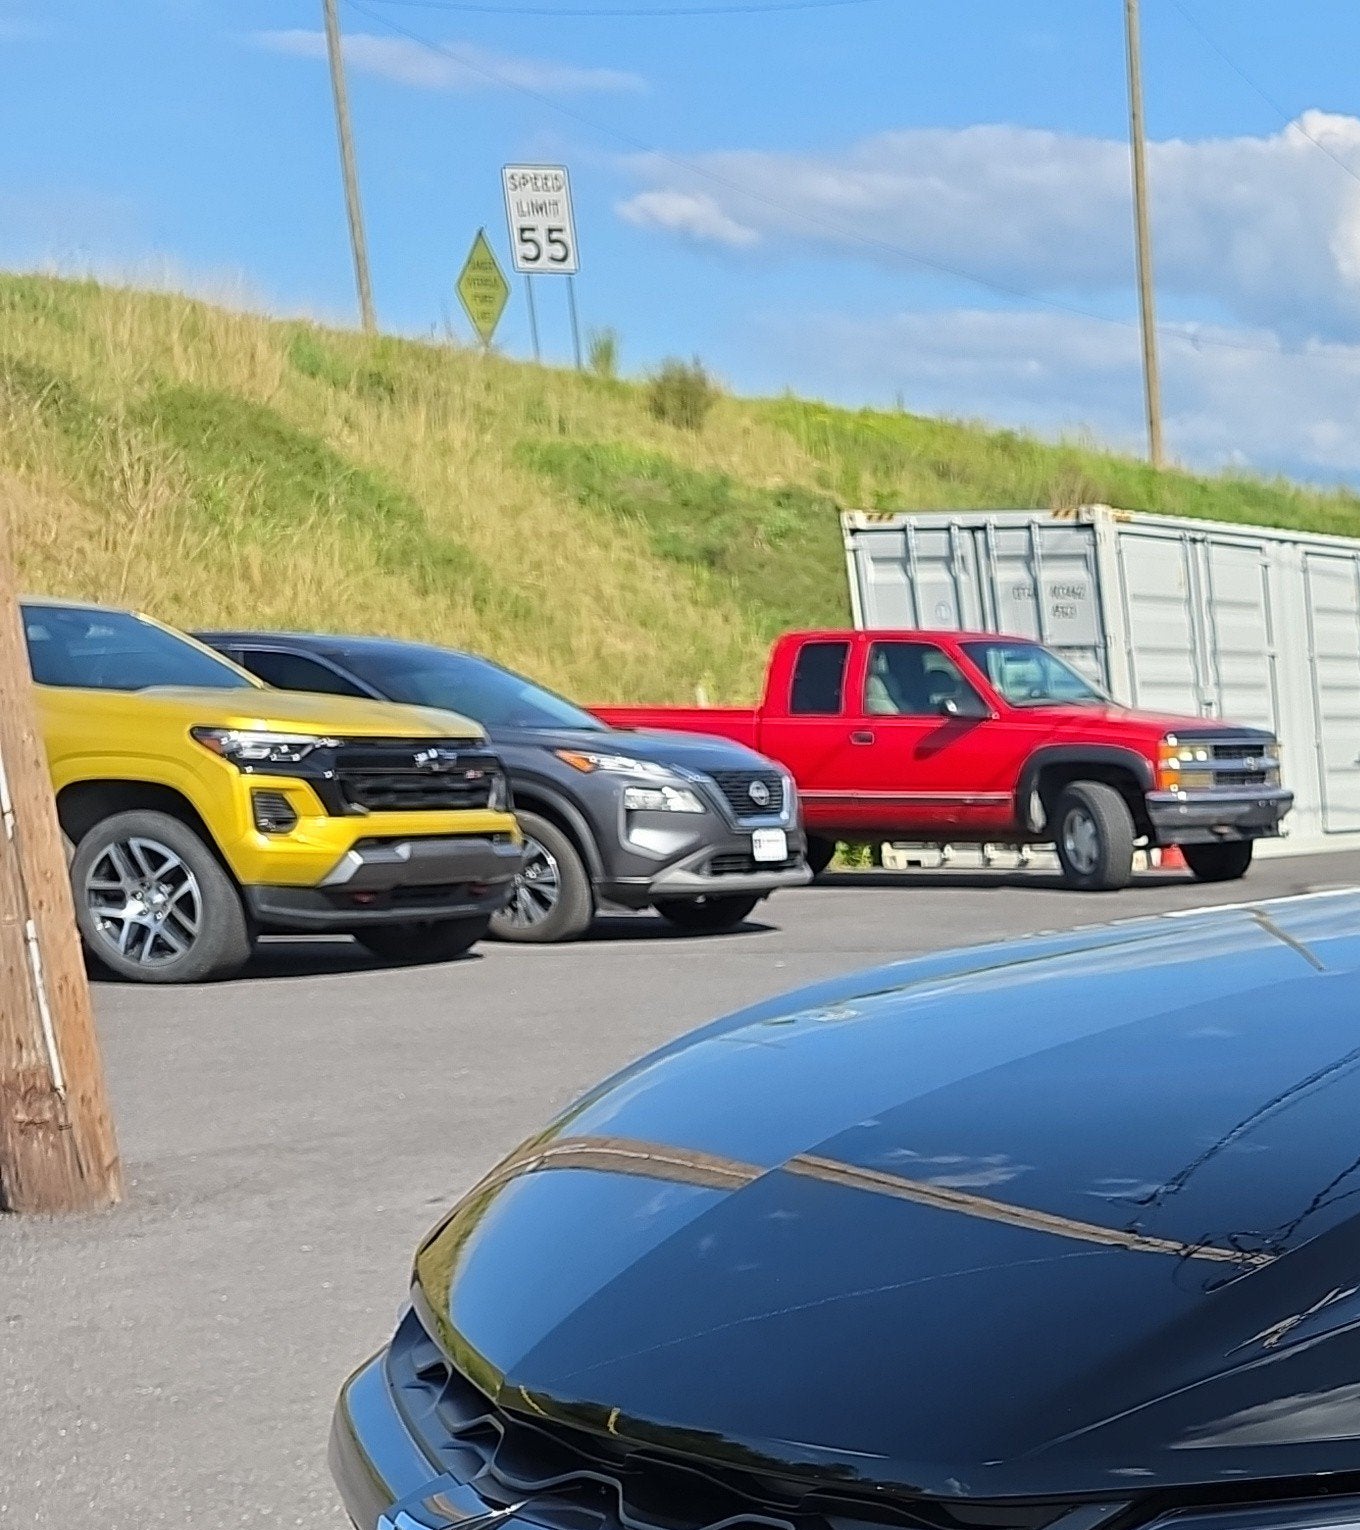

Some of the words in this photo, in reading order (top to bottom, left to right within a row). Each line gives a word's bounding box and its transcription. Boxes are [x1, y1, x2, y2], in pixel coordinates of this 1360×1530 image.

[508, 172, 565, 193] SPEED
[516, 200, 560, 218] LIMIT
[519, 226, 570, 263] 55
